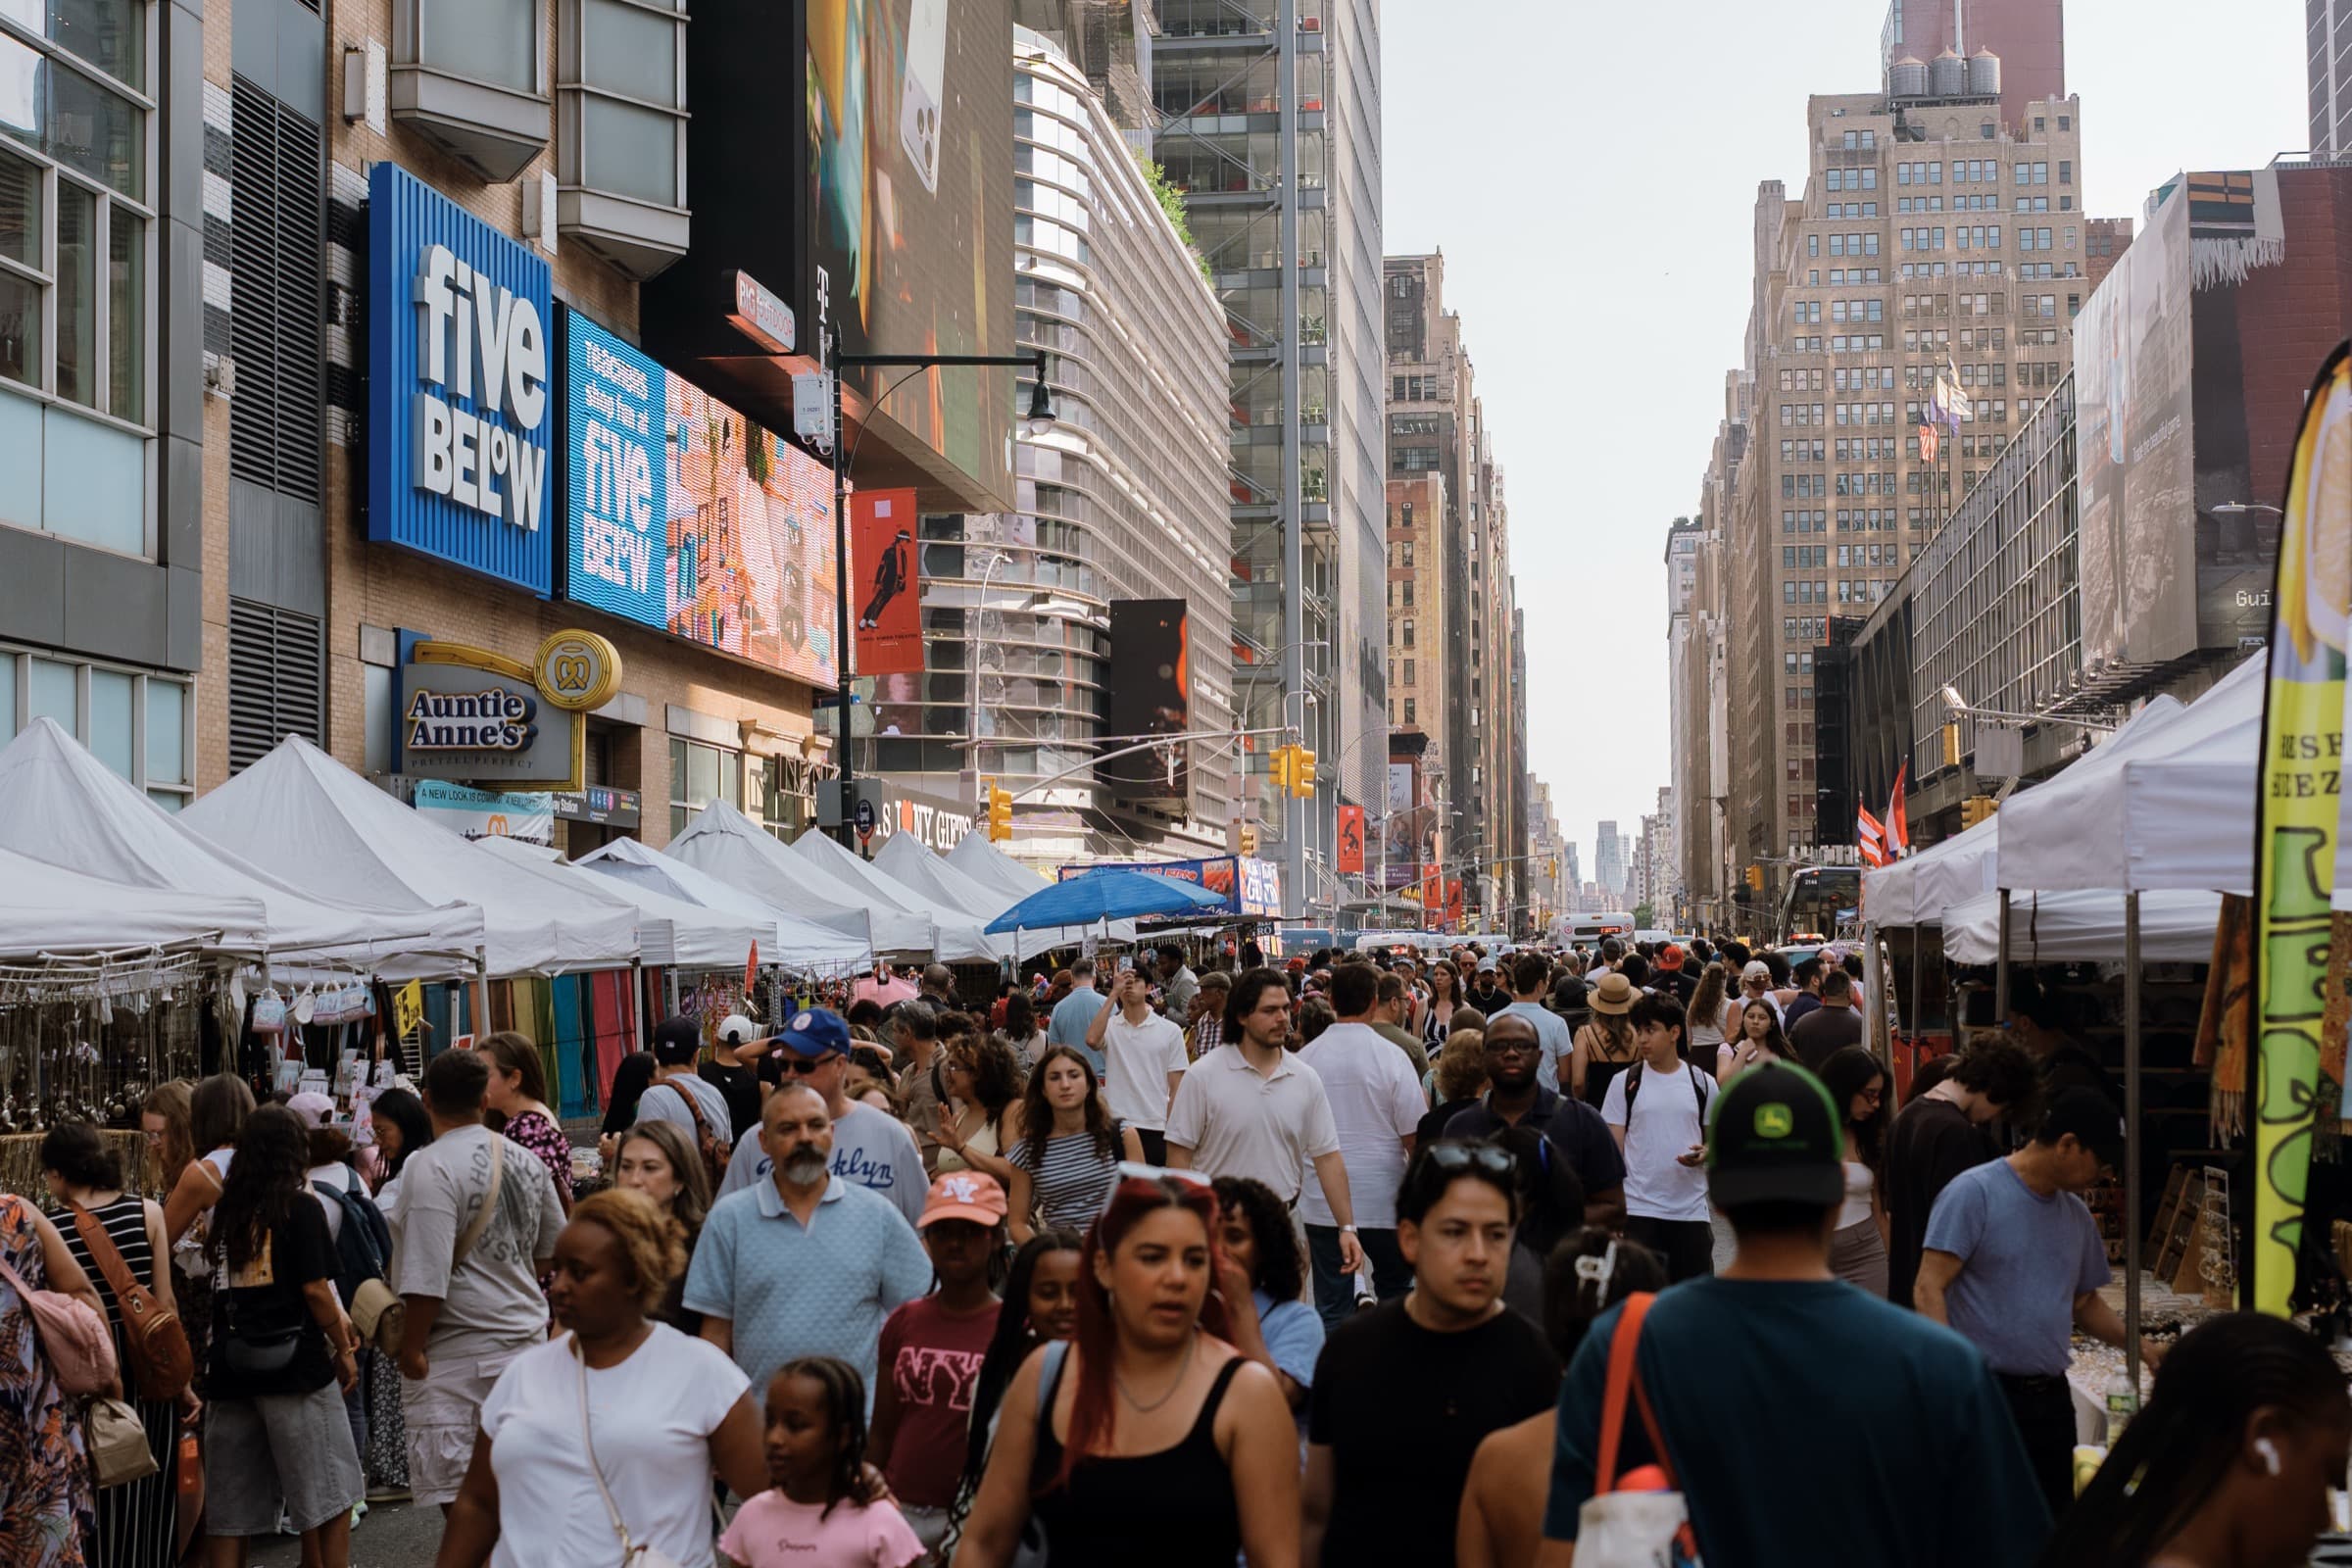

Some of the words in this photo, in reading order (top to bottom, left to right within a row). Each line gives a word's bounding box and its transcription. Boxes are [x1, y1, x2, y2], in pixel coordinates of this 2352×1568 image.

[739, 278, 756, 319] BIG
[758, 297, 793, 338] OUTDOOR
[416, 244, 545, 429] five
[415, 393, 545, 532] BELOW
[583, 419, 652, 533] five
[583, 512, 651, 594] BELOW
[409, 690, 523, 718] Auntie
[410, 720, 520, 747] Anne's
[412, 756, 469, 768] PRETZEL
[421, 788, 427, 798] A
[428, 789, 448, 801] NEW
[448, 790, 468, 802] LOOK
[469, 792, 476, 802] IS
[895, 801, 902, 832] I
[912, 803, 934, 847] NY
[936, 810, 972, 851] GIFTS
[942, 1177, 979, 1203] NY
